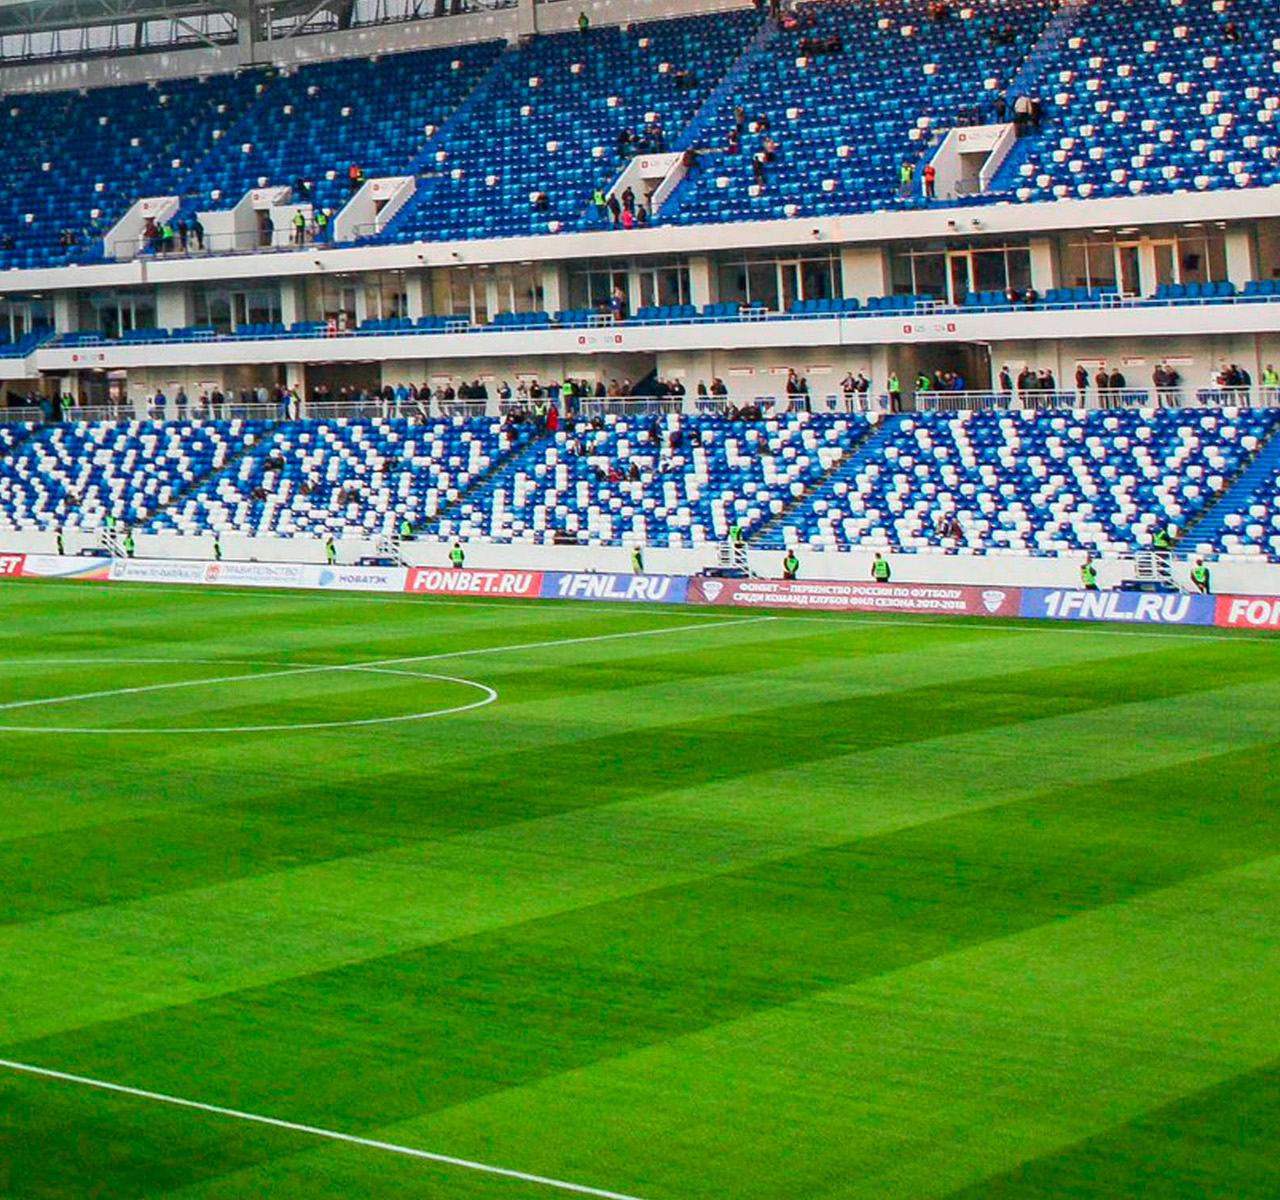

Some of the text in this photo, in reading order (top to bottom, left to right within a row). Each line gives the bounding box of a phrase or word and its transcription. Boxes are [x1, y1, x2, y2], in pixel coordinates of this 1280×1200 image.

[340, 575, 387, 584] НОВАТЭК
[413, 571, 532, 593] FONBET.RU
[557, 574, 670, 600] 1FNL.RU
[733, 592, 763, 602] СРЕДИ
[765, 593, 808, 604] КОМАНД
[809, 595, 848, 605] КЛУБОВ
[875, 598, 915, 608] СЕЗОНА
[791, 584, 851, 595] ПЕРВЕНСТВО
[852, 586, 891, 596] РОССИИ
[893, 588, 910, 597] ПО
[911, 588, 962, 599] ФУТБОЛУ
[1044, 591, 1190, 622] 1FNL.RU
